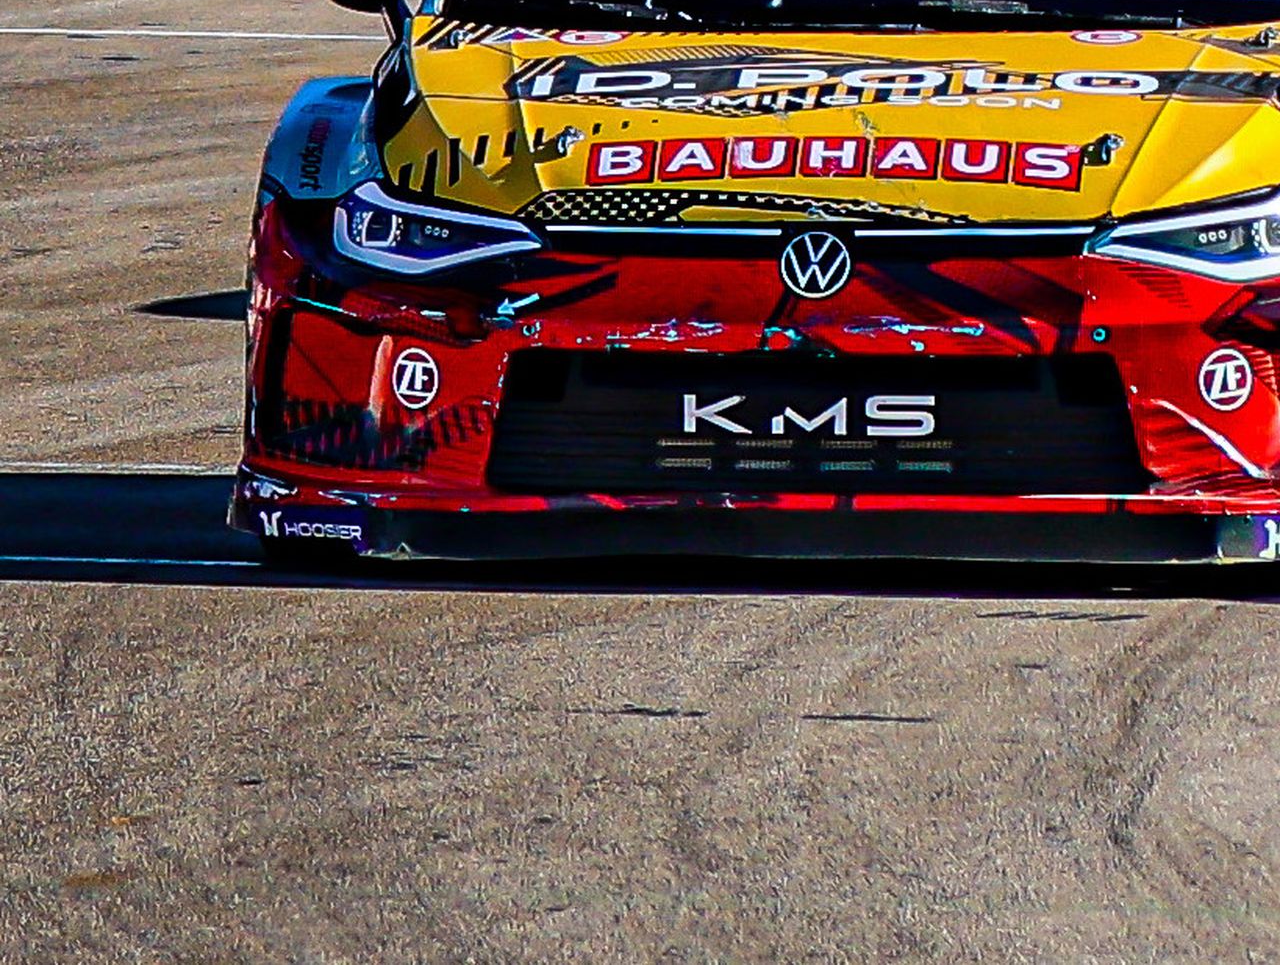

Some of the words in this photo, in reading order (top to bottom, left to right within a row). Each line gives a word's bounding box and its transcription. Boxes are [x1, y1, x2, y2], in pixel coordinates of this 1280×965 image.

[736, 68, 1160, 95] POLO
[621, 93, 862, 108] COMING
[887, 95, 1063, 111] SOON
[599, 140, 1073, 179] BAUHAUS
[683, 394, 935, 436] KMS
[284, 522, 361, 541] HOOSIER
